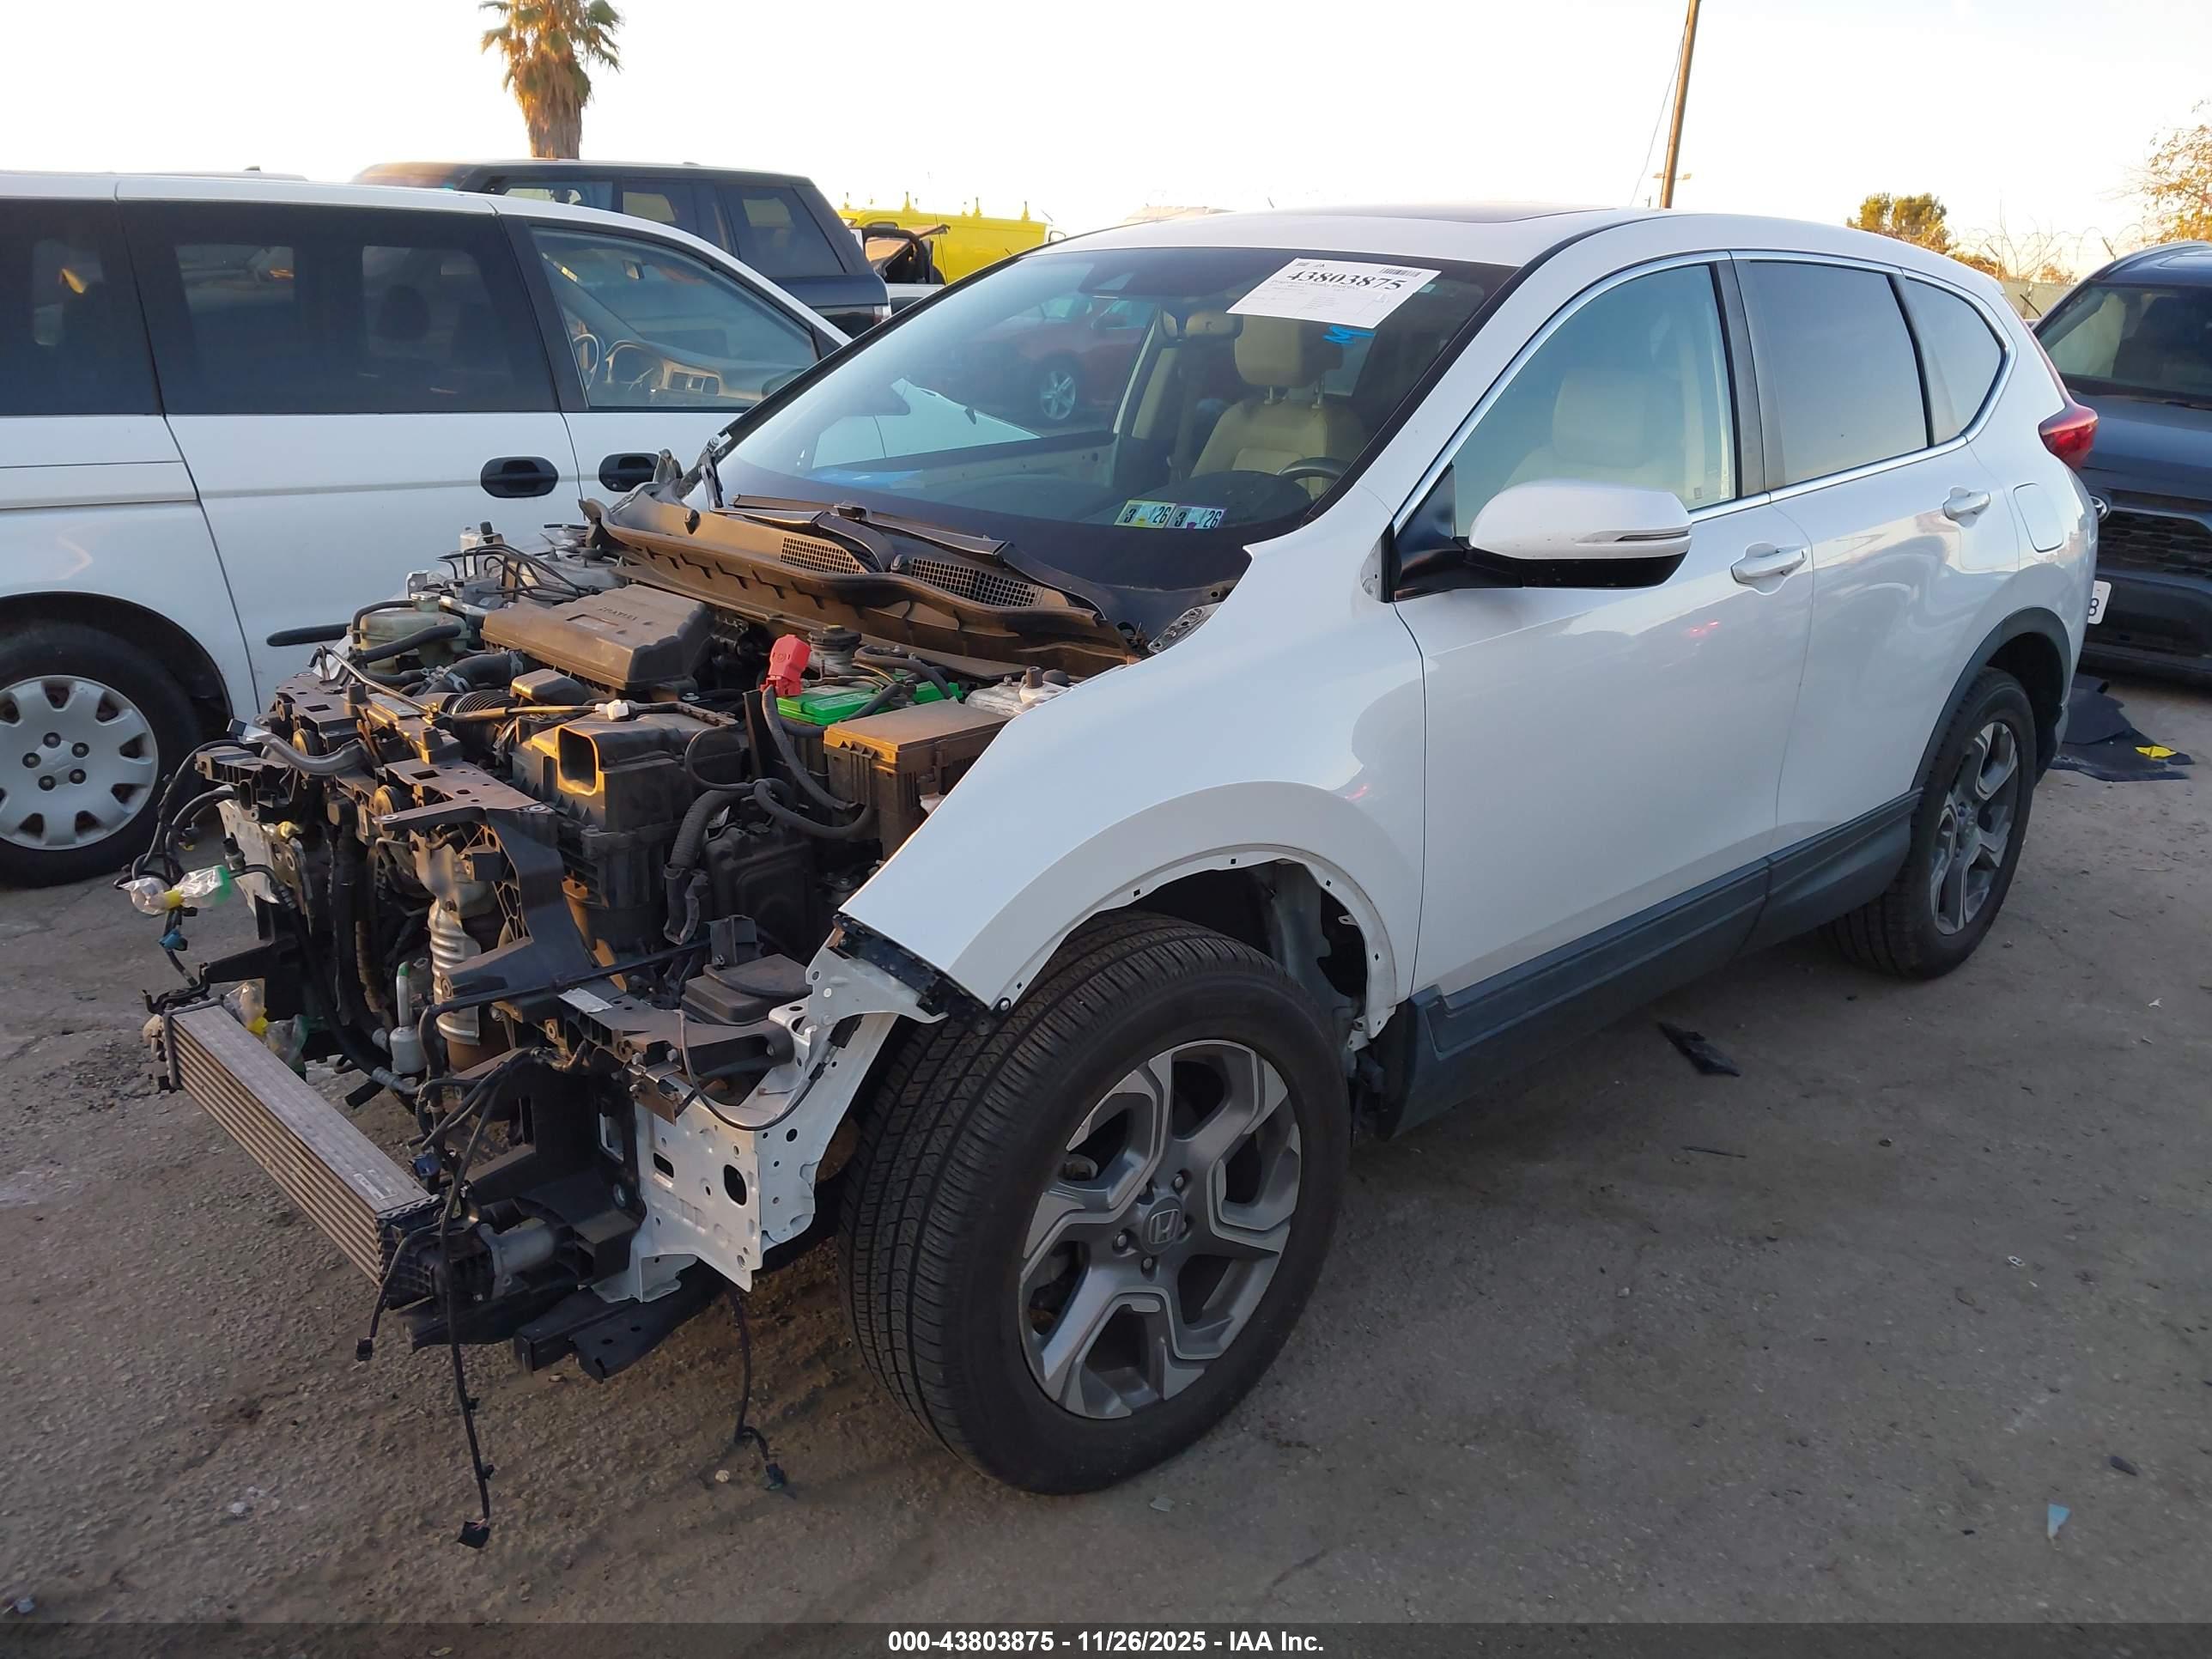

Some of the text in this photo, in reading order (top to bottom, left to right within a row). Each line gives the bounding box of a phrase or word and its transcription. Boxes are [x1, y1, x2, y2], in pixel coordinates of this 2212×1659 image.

[1286, 270, 1408, 290] 43803875
[1152, 506, 1171, 524] 26
[1202, 510, 1223, 529] 26
